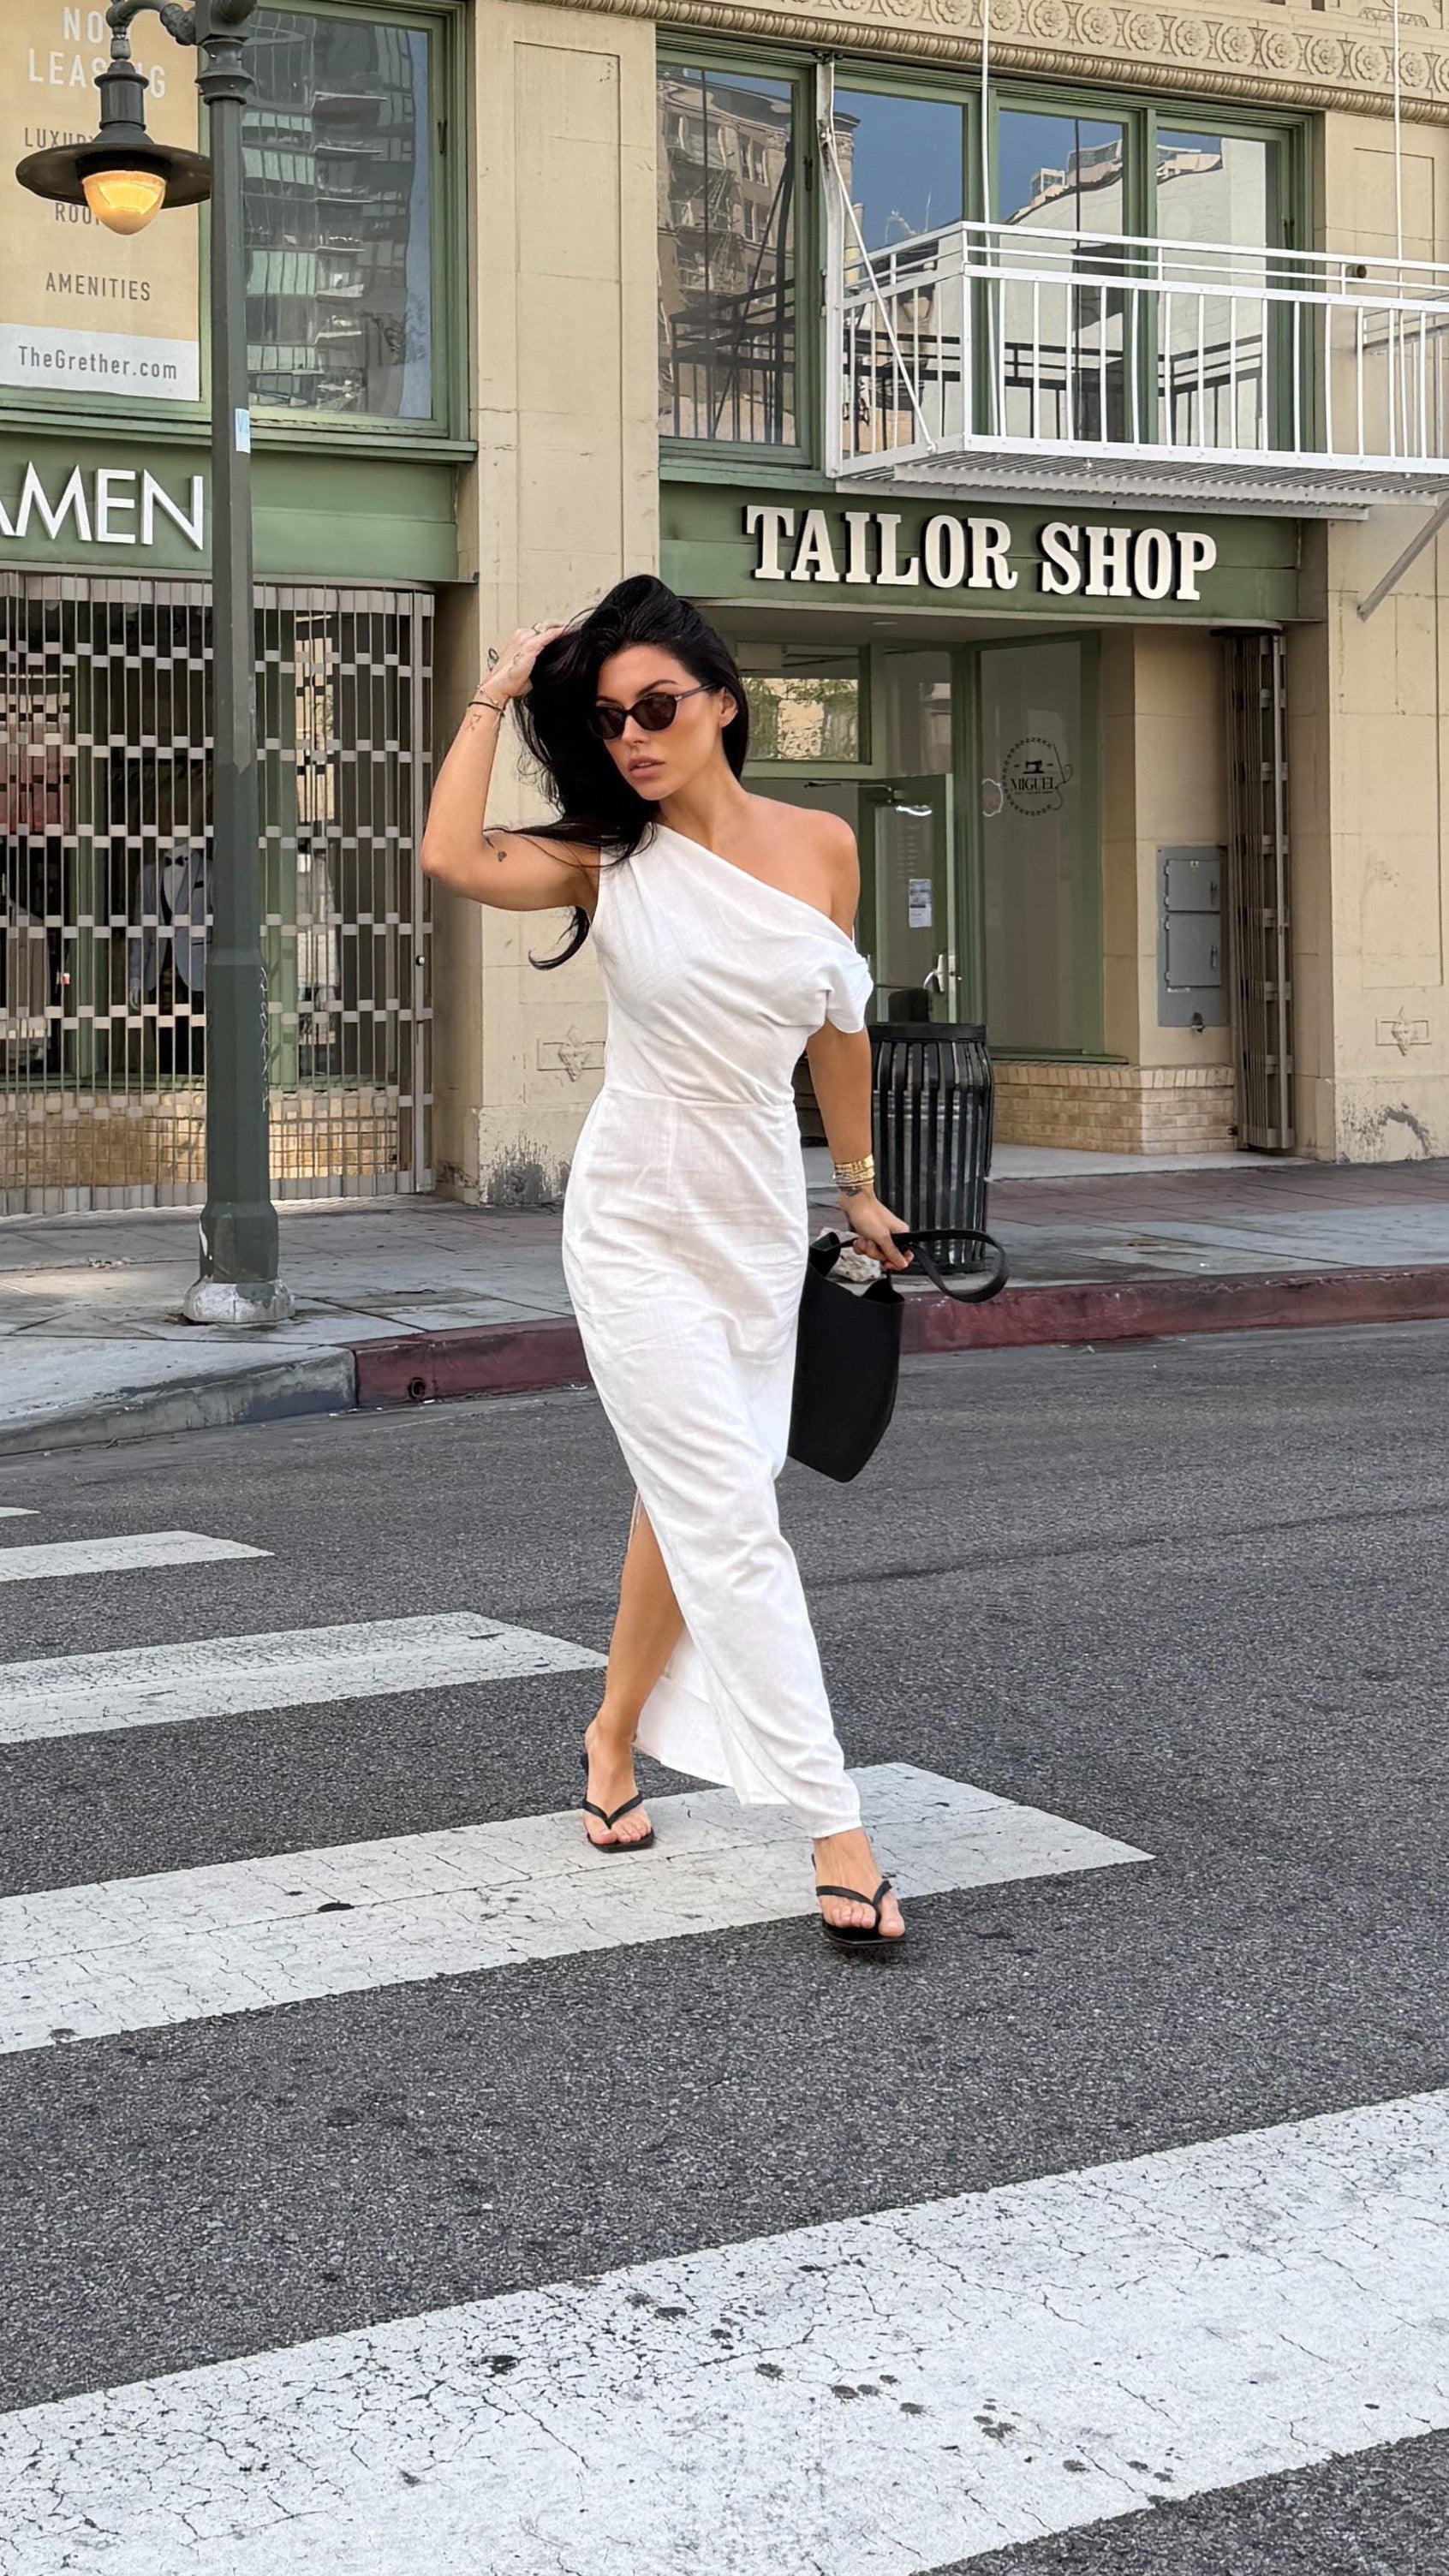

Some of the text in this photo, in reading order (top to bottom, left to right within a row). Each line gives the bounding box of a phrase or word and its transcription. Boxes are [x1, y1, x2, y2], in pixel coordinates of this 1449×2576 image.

[63, 6, 106, 45] NO
[45, 272, 151, 301] AMENITIES
[18, 345, 177, 379] TheGrether.com
[746, 504, 1217, 600] TAILOR SHOP
[1011, 777, 1054, 791] MIGUEL
